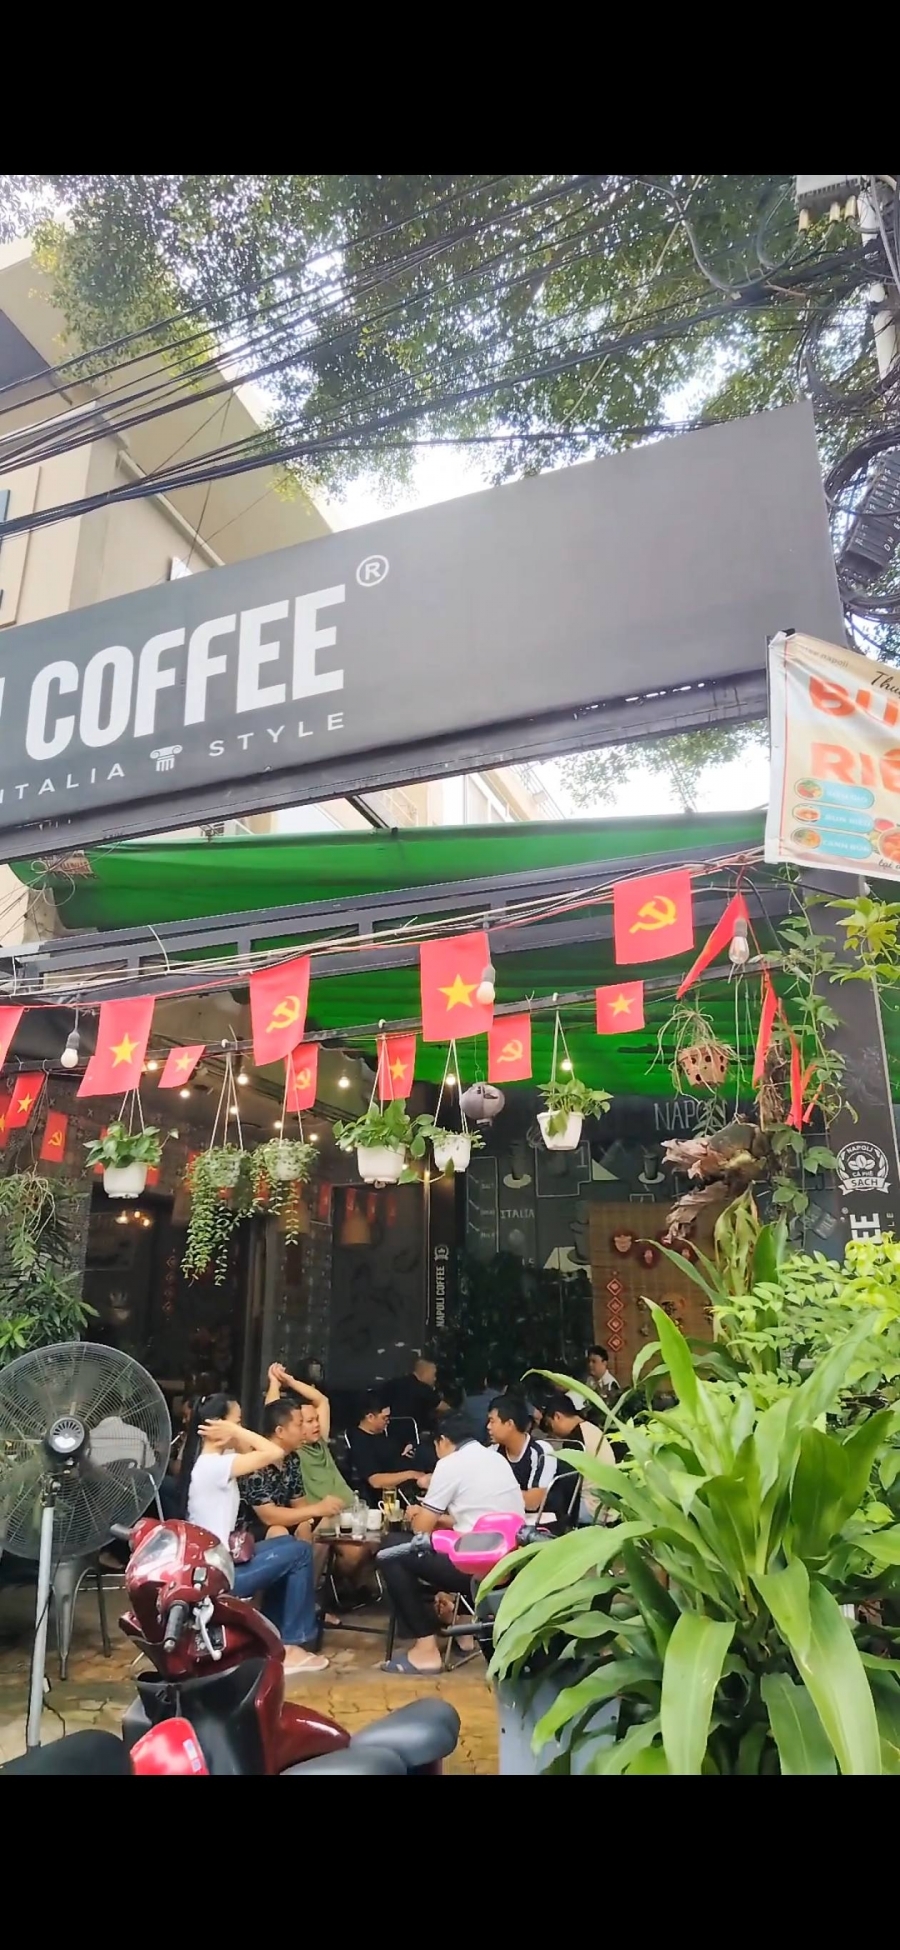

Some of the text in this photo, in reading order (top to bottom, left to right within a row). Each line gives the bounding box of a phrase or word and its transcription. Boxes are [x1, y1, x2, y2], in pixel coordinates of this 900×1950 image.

[25, 584, 346, 761] COFFEE
[0, 712, 345, 804] ITALIA STYLE
[846, 1145, 874, 1154] NAPOLI
[500, 1209, 535, 1219] ITALIA
[436, 1266, 445, 1328] NAPOLI COFFEE
